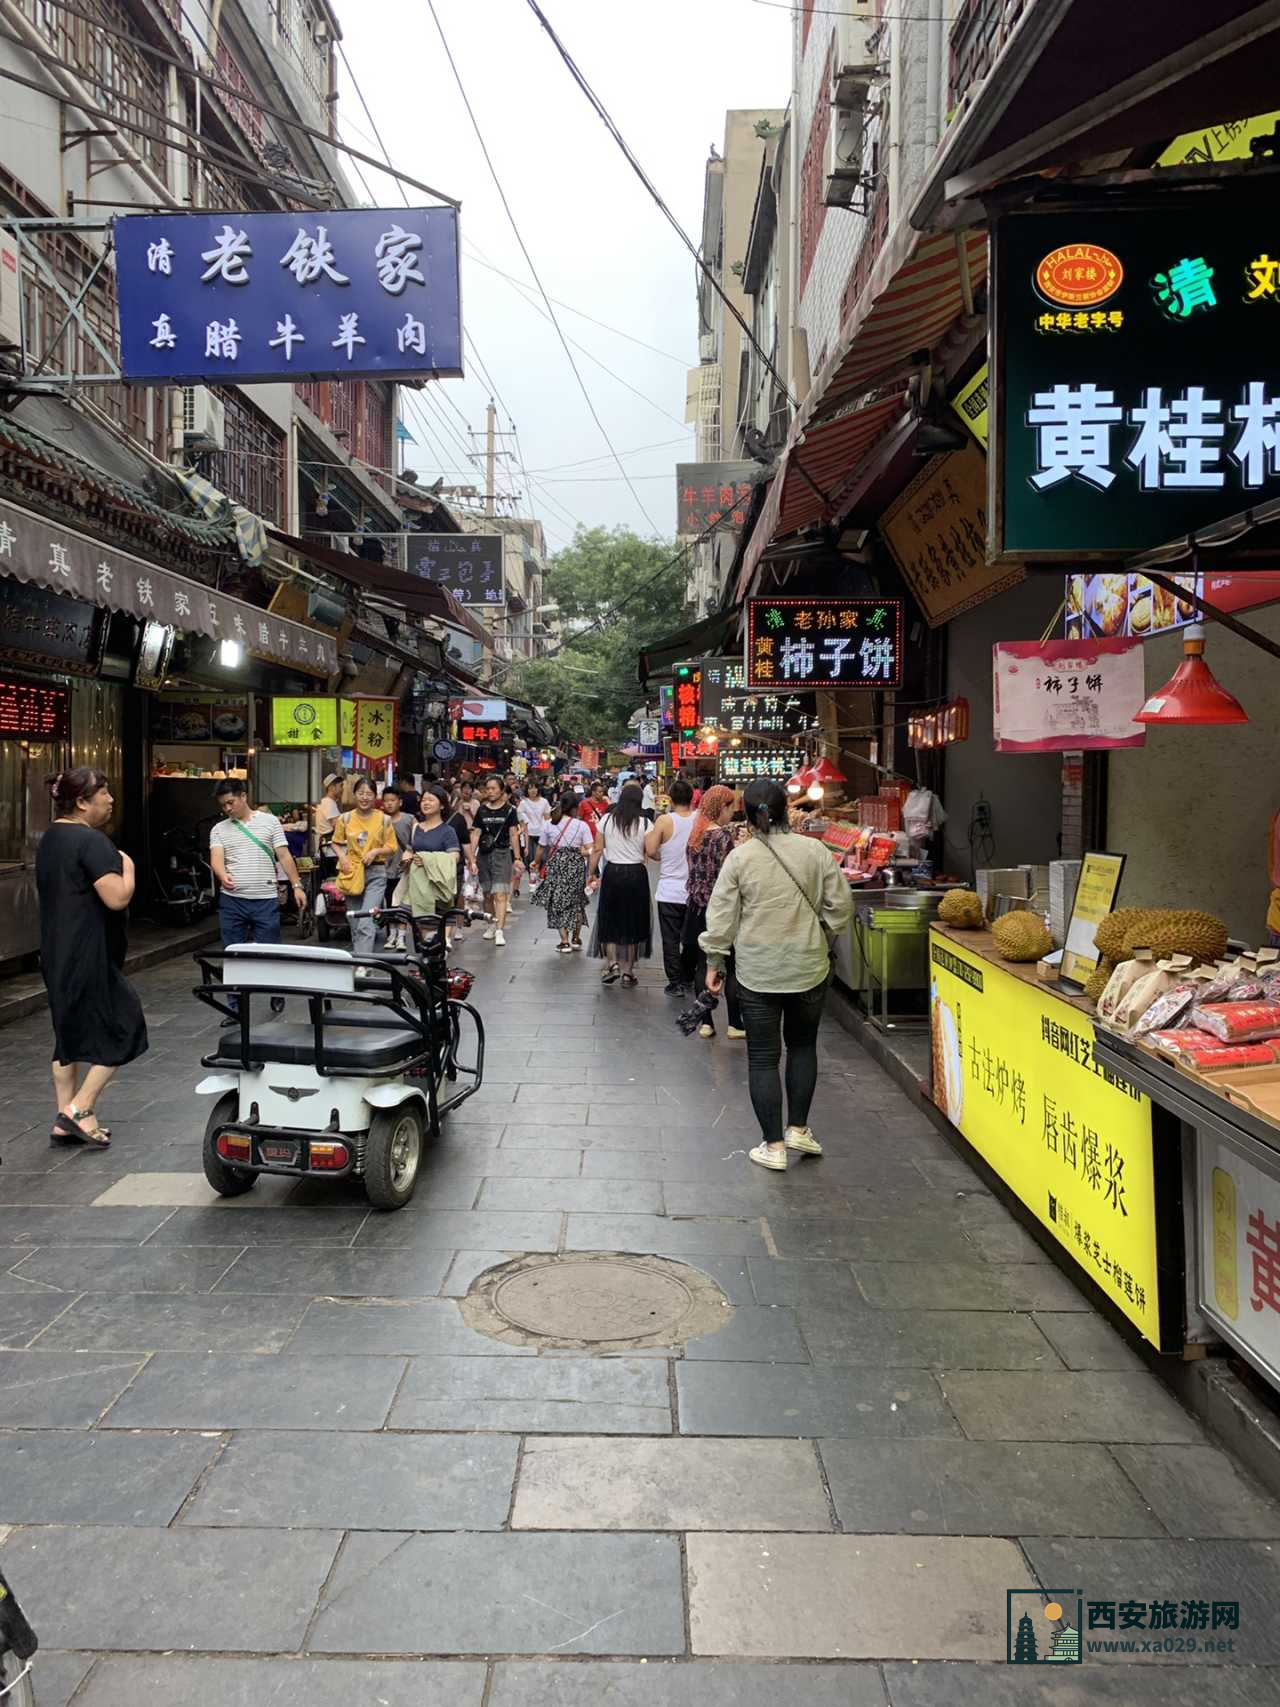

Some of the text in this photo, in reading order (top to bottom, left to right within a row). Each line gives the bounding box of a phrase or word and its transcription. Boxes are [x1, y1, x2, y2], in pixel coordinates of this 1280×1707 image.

[200, 223, 427, 295] 老铁家
[1045, 247, 1092, 269] HALAL
[1154, 256, 1217, 316] 清
[205, 312, 427, 362] 腊牛羊肉
[1039, 311, 1123, 329] 中华老字号
[794, 610, 859, 630] 老孙家
[755, 636, 774, 679] 黄桂
[779, 636, 895, 679] 柿子饼
[1044, 674, 1104, 695] 柿子饼
[368, 709, 385, 748] 冰粉
[968, 1035, 1128, 1216] 古法炉烤 唇齿爆浆
